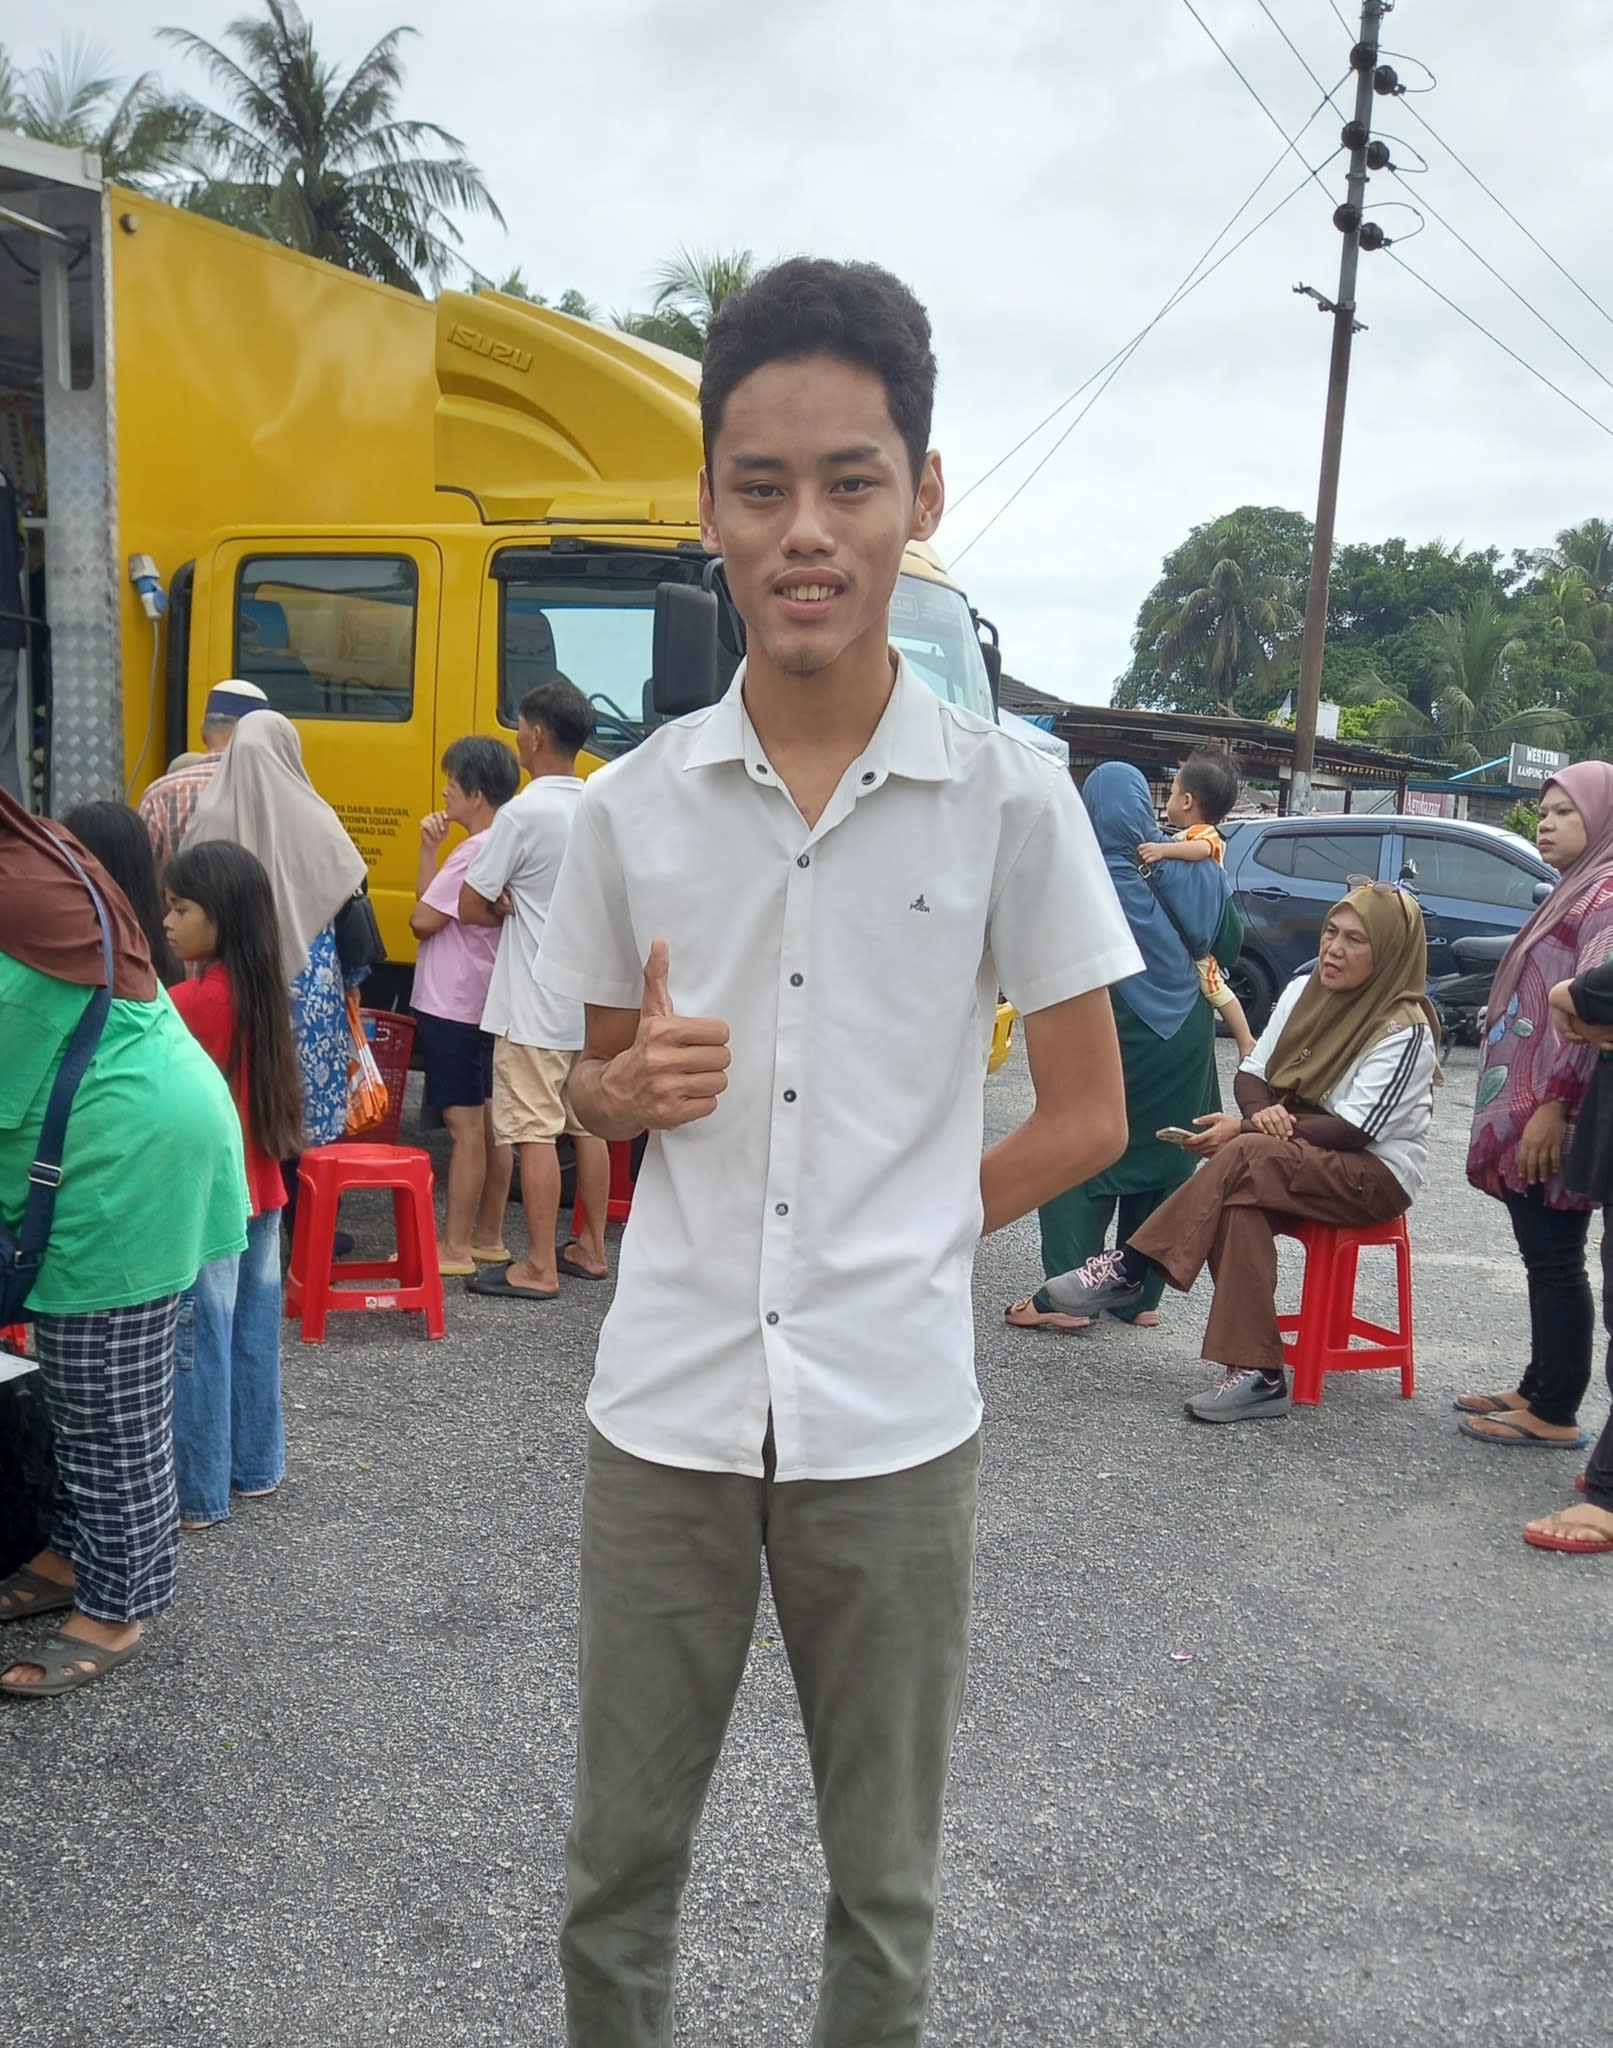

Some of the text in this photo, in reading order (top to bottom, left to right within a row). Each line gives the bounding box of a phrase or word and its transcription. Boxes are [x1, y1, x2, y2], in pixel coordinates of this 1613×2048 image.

[446, 324, 535, 374] ISUZU
[1527, 747, 1559, 766] WESTERN
[347, 805, 372, 814] DARUL
